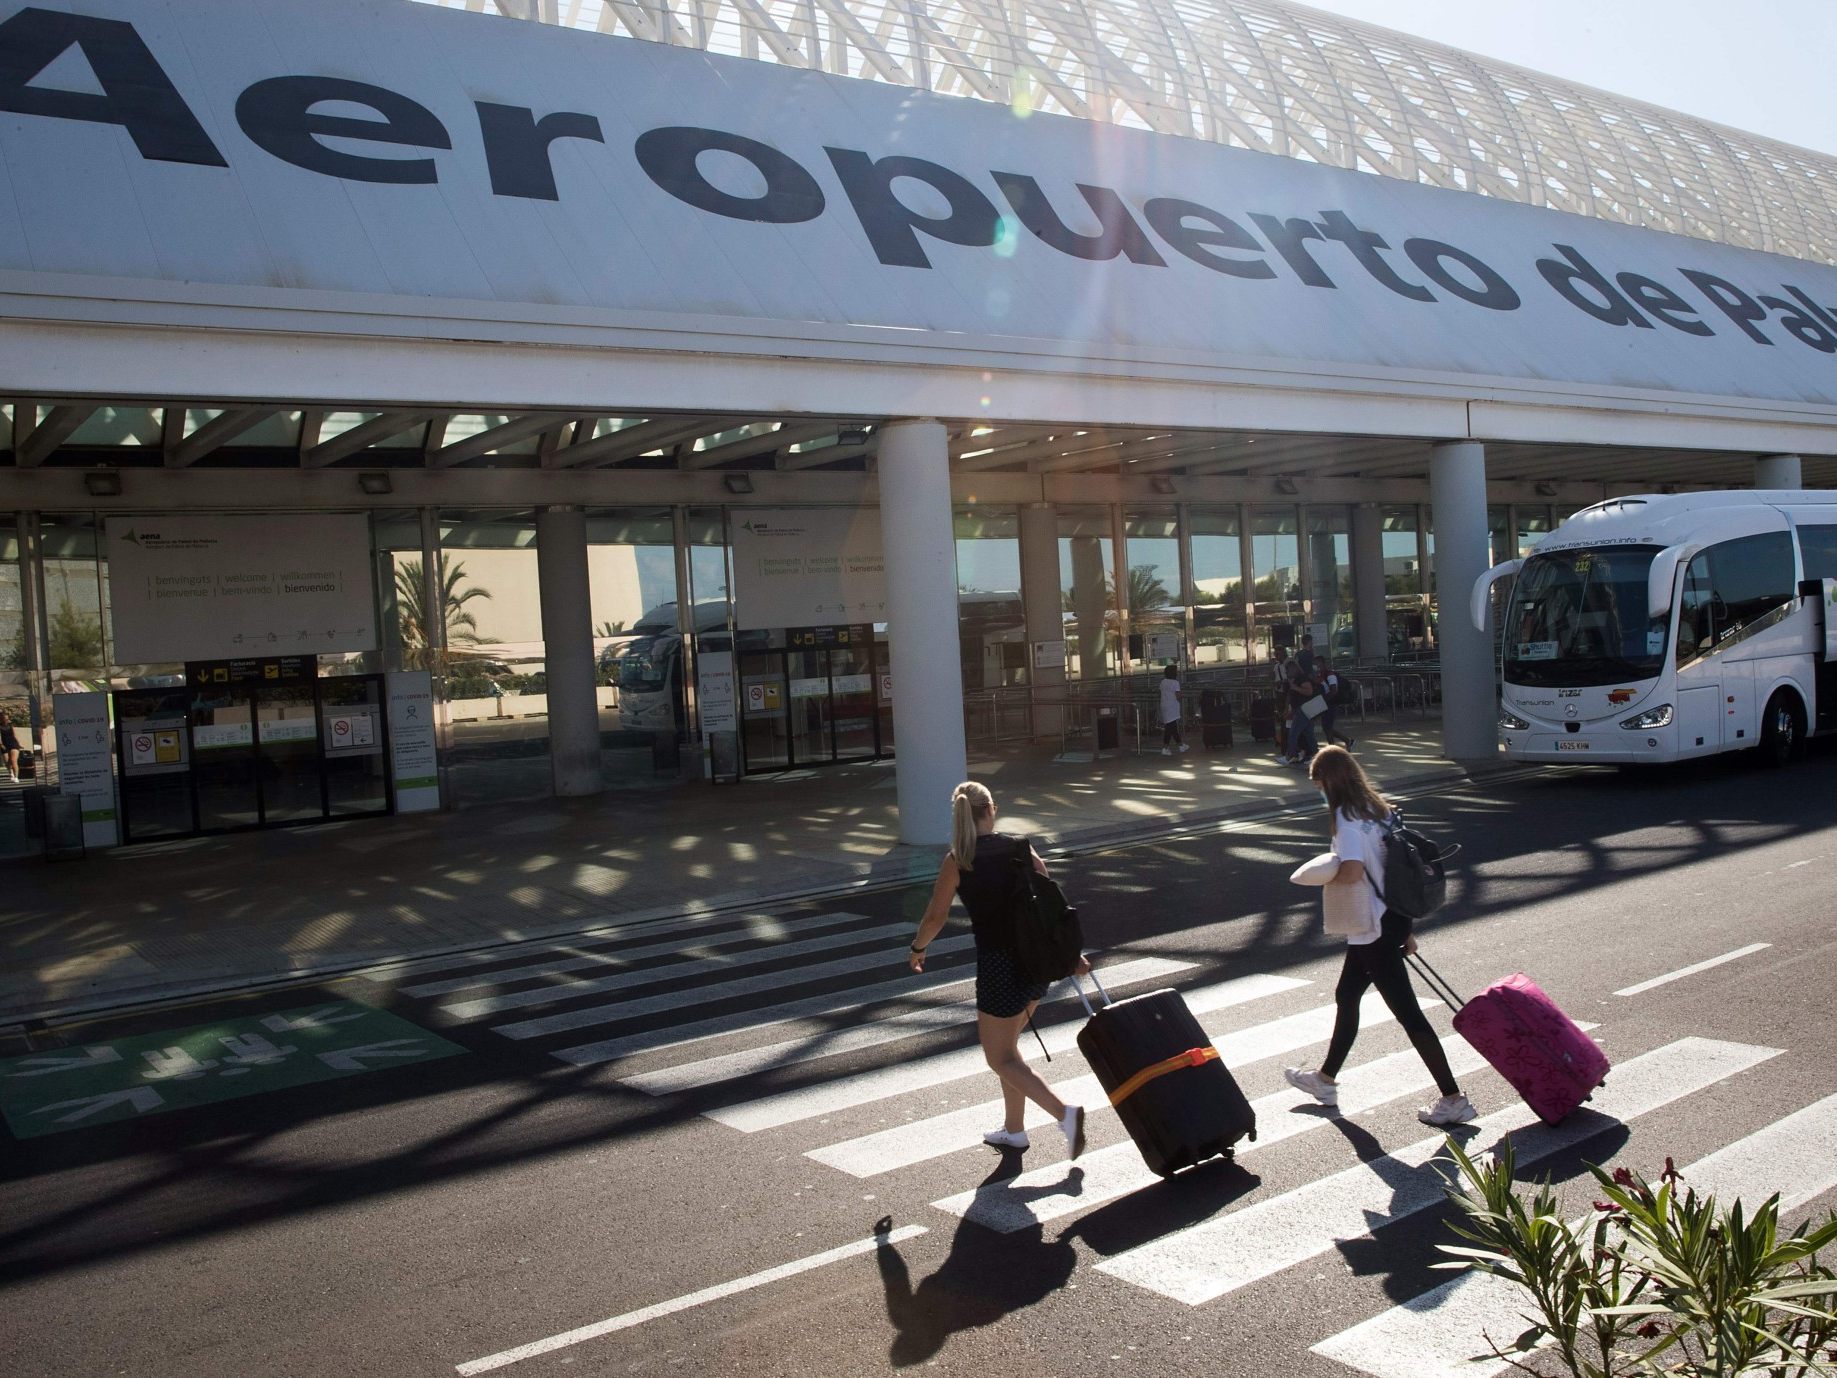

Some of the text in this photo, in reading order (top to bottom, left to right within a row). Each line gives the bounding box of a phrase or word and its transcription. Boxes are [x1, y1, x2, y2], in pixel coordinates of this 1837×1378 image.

[0, 7, 1837, 354] Aeropuerto de Pal
[140, 532, 161, 540] aena
[1545, 537, 1637, 551] www.transunion.info
[156, 570, 336, 586] benvinguts welcome willkommen
[157, 583, 336, 598] bienvenue bem-vindo bienvenido
